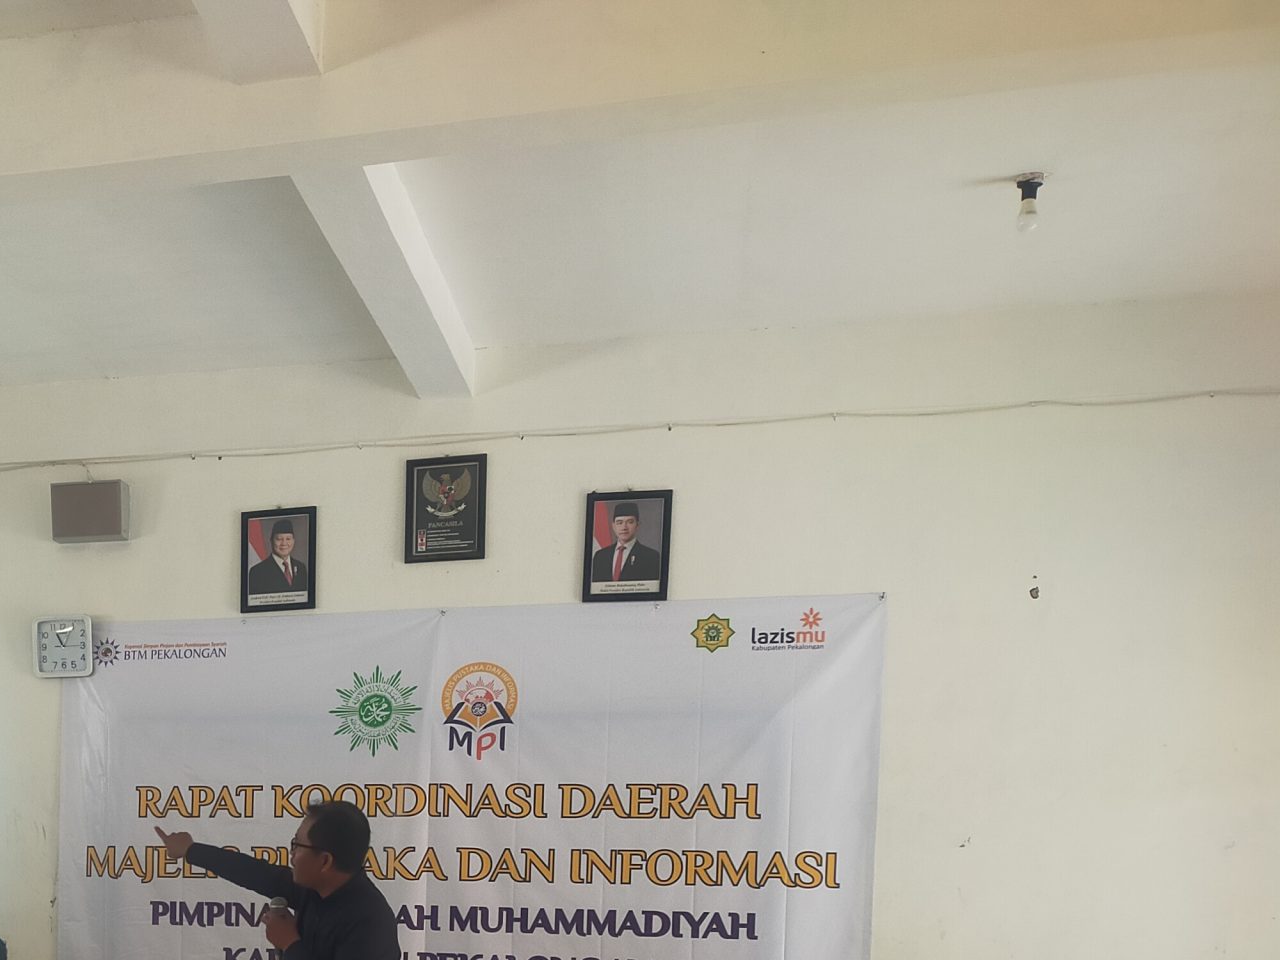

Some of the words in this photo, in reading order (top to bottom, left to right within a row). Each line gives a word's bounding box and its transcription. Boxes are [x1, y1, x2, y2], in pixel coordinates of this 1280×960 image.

[752, 627, 825, 644] lazismu
[124, 650, 147, 660] BTM
[151, 648, 227, 660] PEKALONGAN
[448, 726, 506, 760] MPI
[135, 785, 263, 819] RAPAT
[271, 783, 548, 819] KOORDINASI
[558, 783, 761, 819] DAERAH
[86, 845, 240, 883] MAJEL
[456, 847, 555, 883] DAN
[570, 848, 840, 889] INFORMASI
[449, 905, 759, 940] MUHAMMADIYAH
